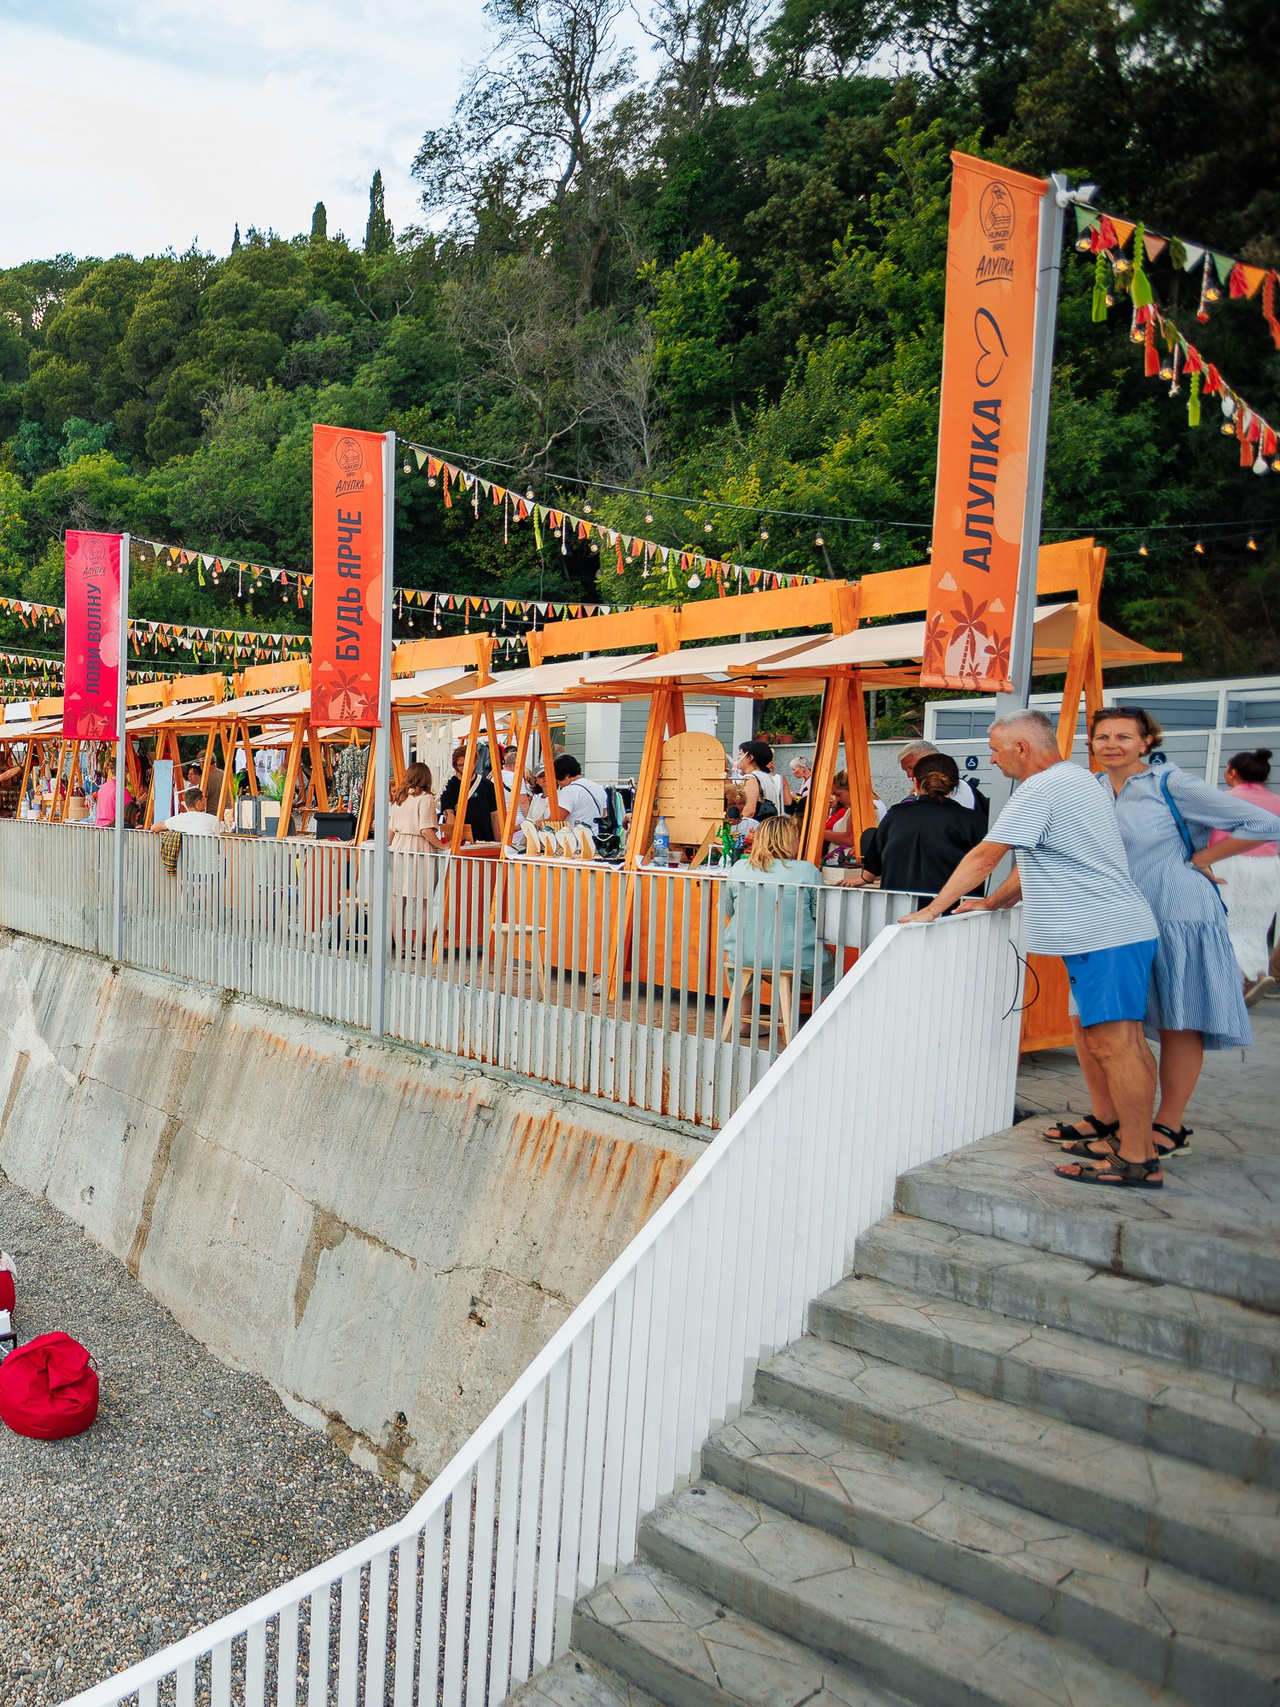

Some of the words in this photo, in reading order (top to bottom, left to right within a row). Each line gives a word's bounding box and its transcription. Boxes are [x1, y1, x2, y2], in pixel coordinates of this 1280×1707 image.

[988, 229, 1010, 239] HUNGRY
[962, 398, 1002, 573] АЛУПКА
[336, 508, 362, 580] ЯРЧЕ
[86, 583, 102, 643] ВОЛНУ
[335, 588, 364, 661] БУДЬ
[85, 647, 101, 696] ЛОВИ
